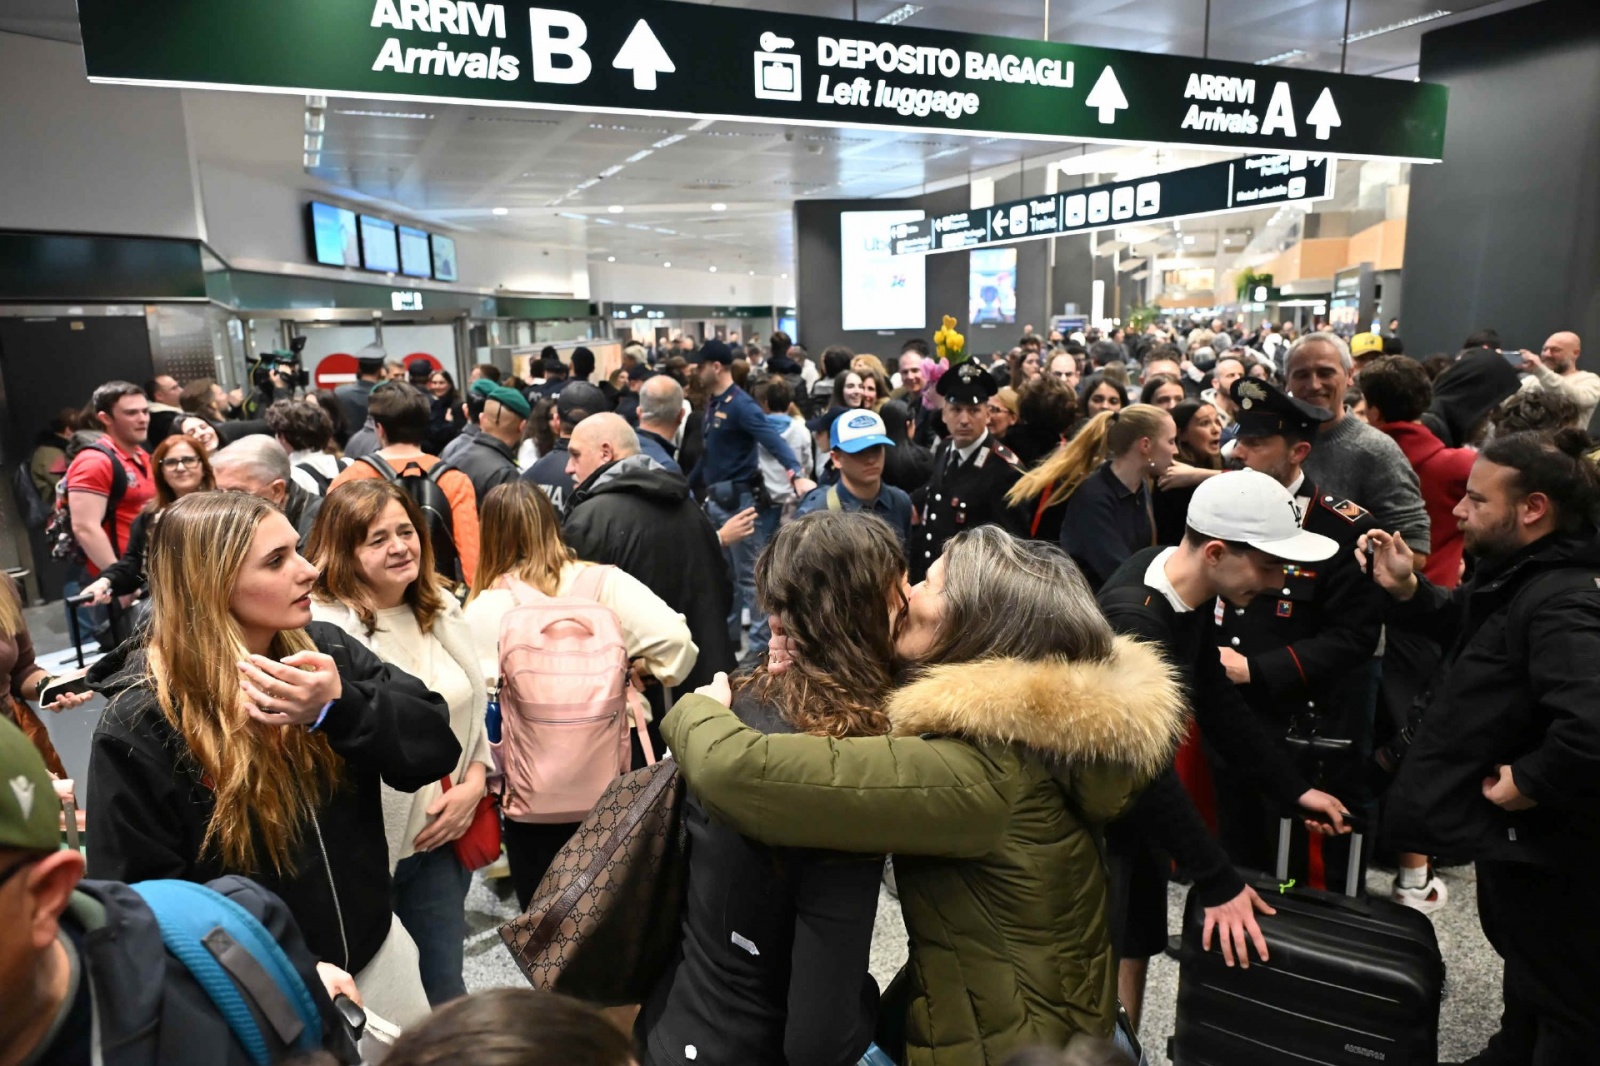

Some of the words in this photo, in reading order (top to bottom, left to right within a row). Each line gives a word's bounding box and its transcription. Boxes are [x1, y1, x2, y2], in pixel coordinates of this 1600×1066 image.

[371, 0, 506, 39] ARRIVI
[371, 38, 520, 82] Arrivals
[529, 7, 592, 84] B
[817, 36, 961, 78] DEPOSITO
[965, 51, 1075, 88] BAGAGLI
[817, 74, 871, 106] Left
[874, 78, 980, 119] luggage
[1184, 73, 1256, 104] ARRIVI
[1260, 81, 1297, 137] A
[1181, 104, 1259, 135] Arrivals
[1029, 215, 1058, 233] Trains
